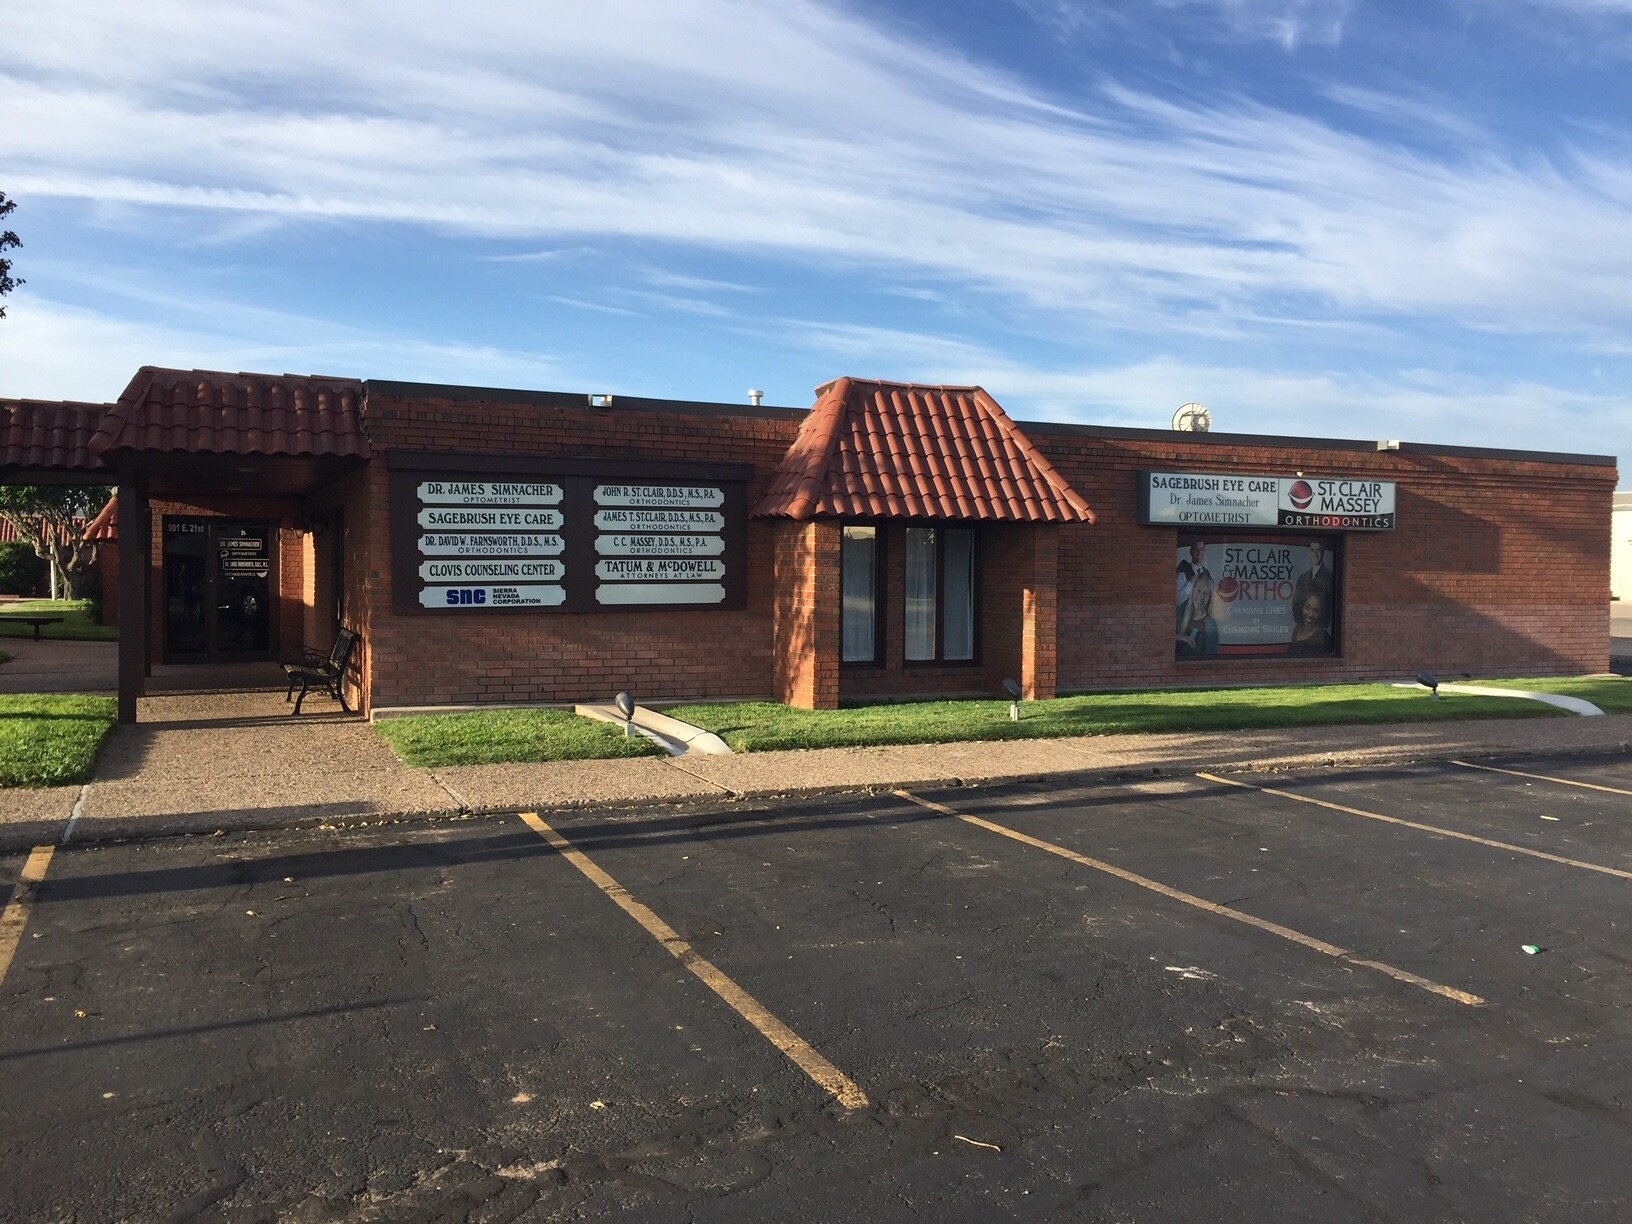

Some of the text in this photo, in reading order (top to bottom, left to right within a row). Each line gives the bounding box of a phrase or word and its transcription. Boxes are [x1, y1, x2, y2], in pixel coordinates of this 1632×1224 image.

[428, 483, 553, 496] DR. JAMES SIMNACHER
[1152, 477, 1276, 493] SAGEBRUSH EYE CARE
[1318, 482, 1382, 497] ST. CLAIR
[602, 487, 621, 496] JOHN
[623, 487, 630, 496] R.
[704, 490, 715, 499] P.A.
[1170, 493, 1259, 507] Dr. James Simnacher
[1321, 497, 1380, 513] MASSEY
[429, 513, 553, 524] SAGEBRUSH EYE CARE
[603, 511, 627, 521] JAMES
[629, 512, 635, 521] T.
[1179, 512, 1251, 523] OPTOMETRIST
[1285, 515, 1389, 527] ORTHODONTICS
[190, 524, 204, 533] 21st
[425, 535, 437, 546] DR.
[438, 535, 459, 546] DAVID
[470, 536, 520, 548] FARNSWORTH,
[544, 536, 559, 547] M.S.
[1225, 548, 1292, 564] ST. CLAIR
[429, 563, 556, 577] CLOVIS COUNSELING CENTER
[605, 561, 642, 572] TATUM
[646, 561, 654, 572] &
